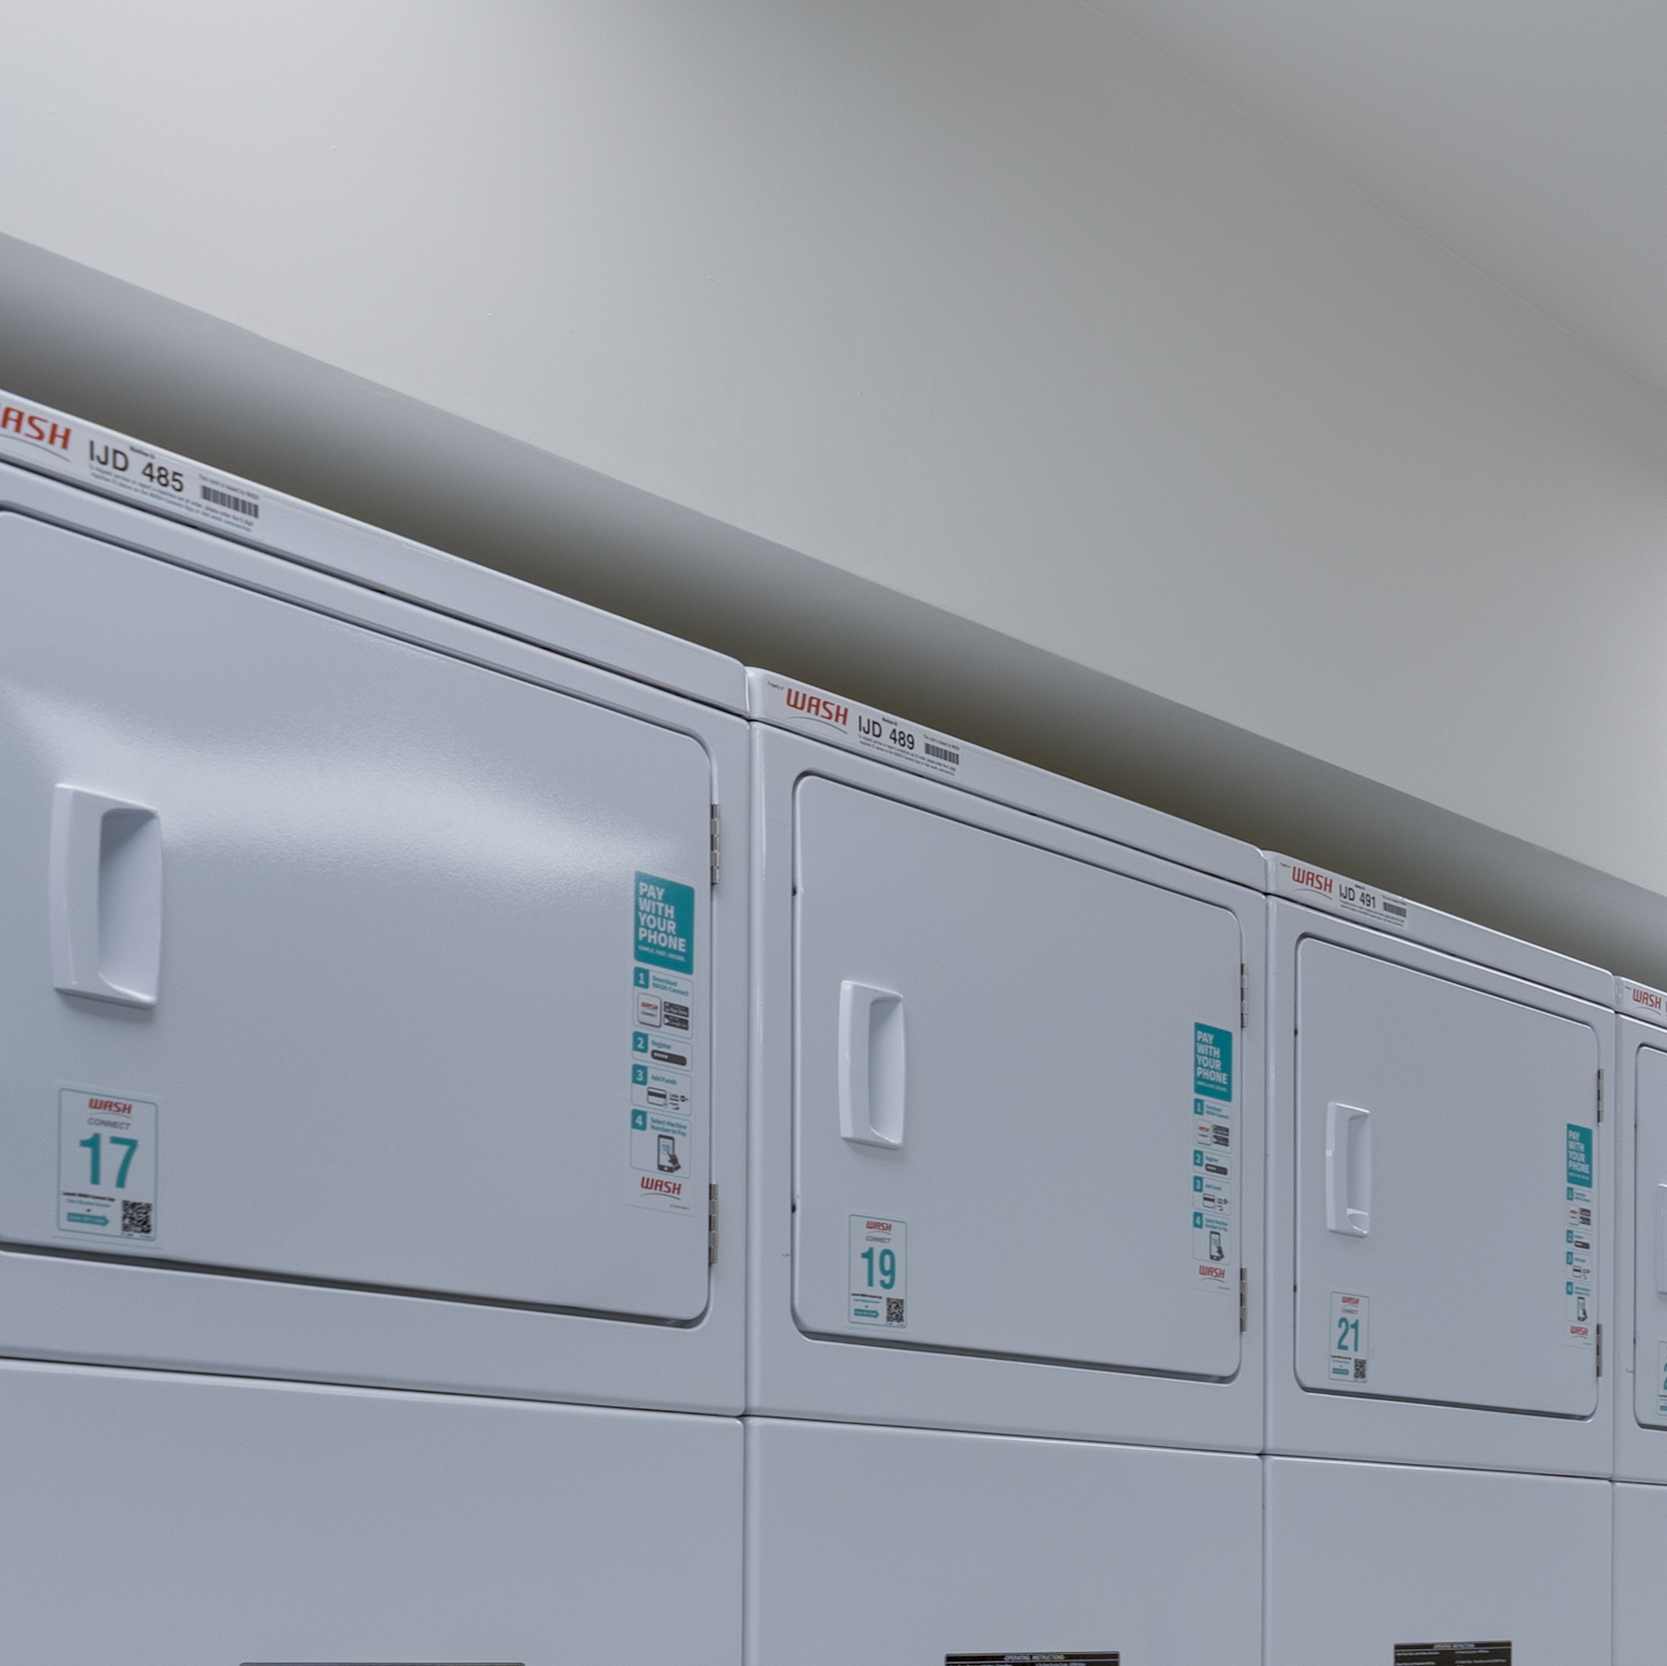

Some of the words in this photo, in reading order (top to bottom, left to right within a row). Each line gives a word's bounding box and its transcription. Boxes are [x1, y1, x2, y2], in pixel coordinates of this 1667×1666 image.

[0, 406, 71, 451] ASH
[89, 440, 129, 472] IJD
[142, 462, 184, 492] 485
[786, 688, 849, 726] WASH
[858, 715, 883, 739] IJD
[889, 728, 915, 751] 489
[639, 881, 665, 901] PAY
[1292, 866, 1333, 894] WASH
[1359, 892, 1376, 909] 491
[638, 896, 675, 919] WITH
[638, 911, 677, 935] YOUR
[638, 927, 687, 953] PHONE
[638, 973, 645, 985] 1
[1632, 988, 1662, 1010] WASH
[637, 1037, 645, 1050] 2
[1197, 1030, 1214, 1045] PAY
[1197, 1042, 1220, 1060] WITH
[1197, 1054, 1222, 1071] YOUR
[636, 1070, 644, 1082] 3
[1197, 1066, 1229, 1086] PHONE
[89, 1098, 133, 1114] WASH
[87, 1117, 132, 1130] CONNECT
[635, 1115, 644, 1127] 4
[80, 1132, 139, 1188] 17
[641, 1176, 682, 1196] WASH
[866, 1220, 892, 1231] WASH
[861, 1246, 895, 1290] 19
[1199, 1265, 1225, 1280] WASH
[1337, 1316, 1359, 1352] 21
